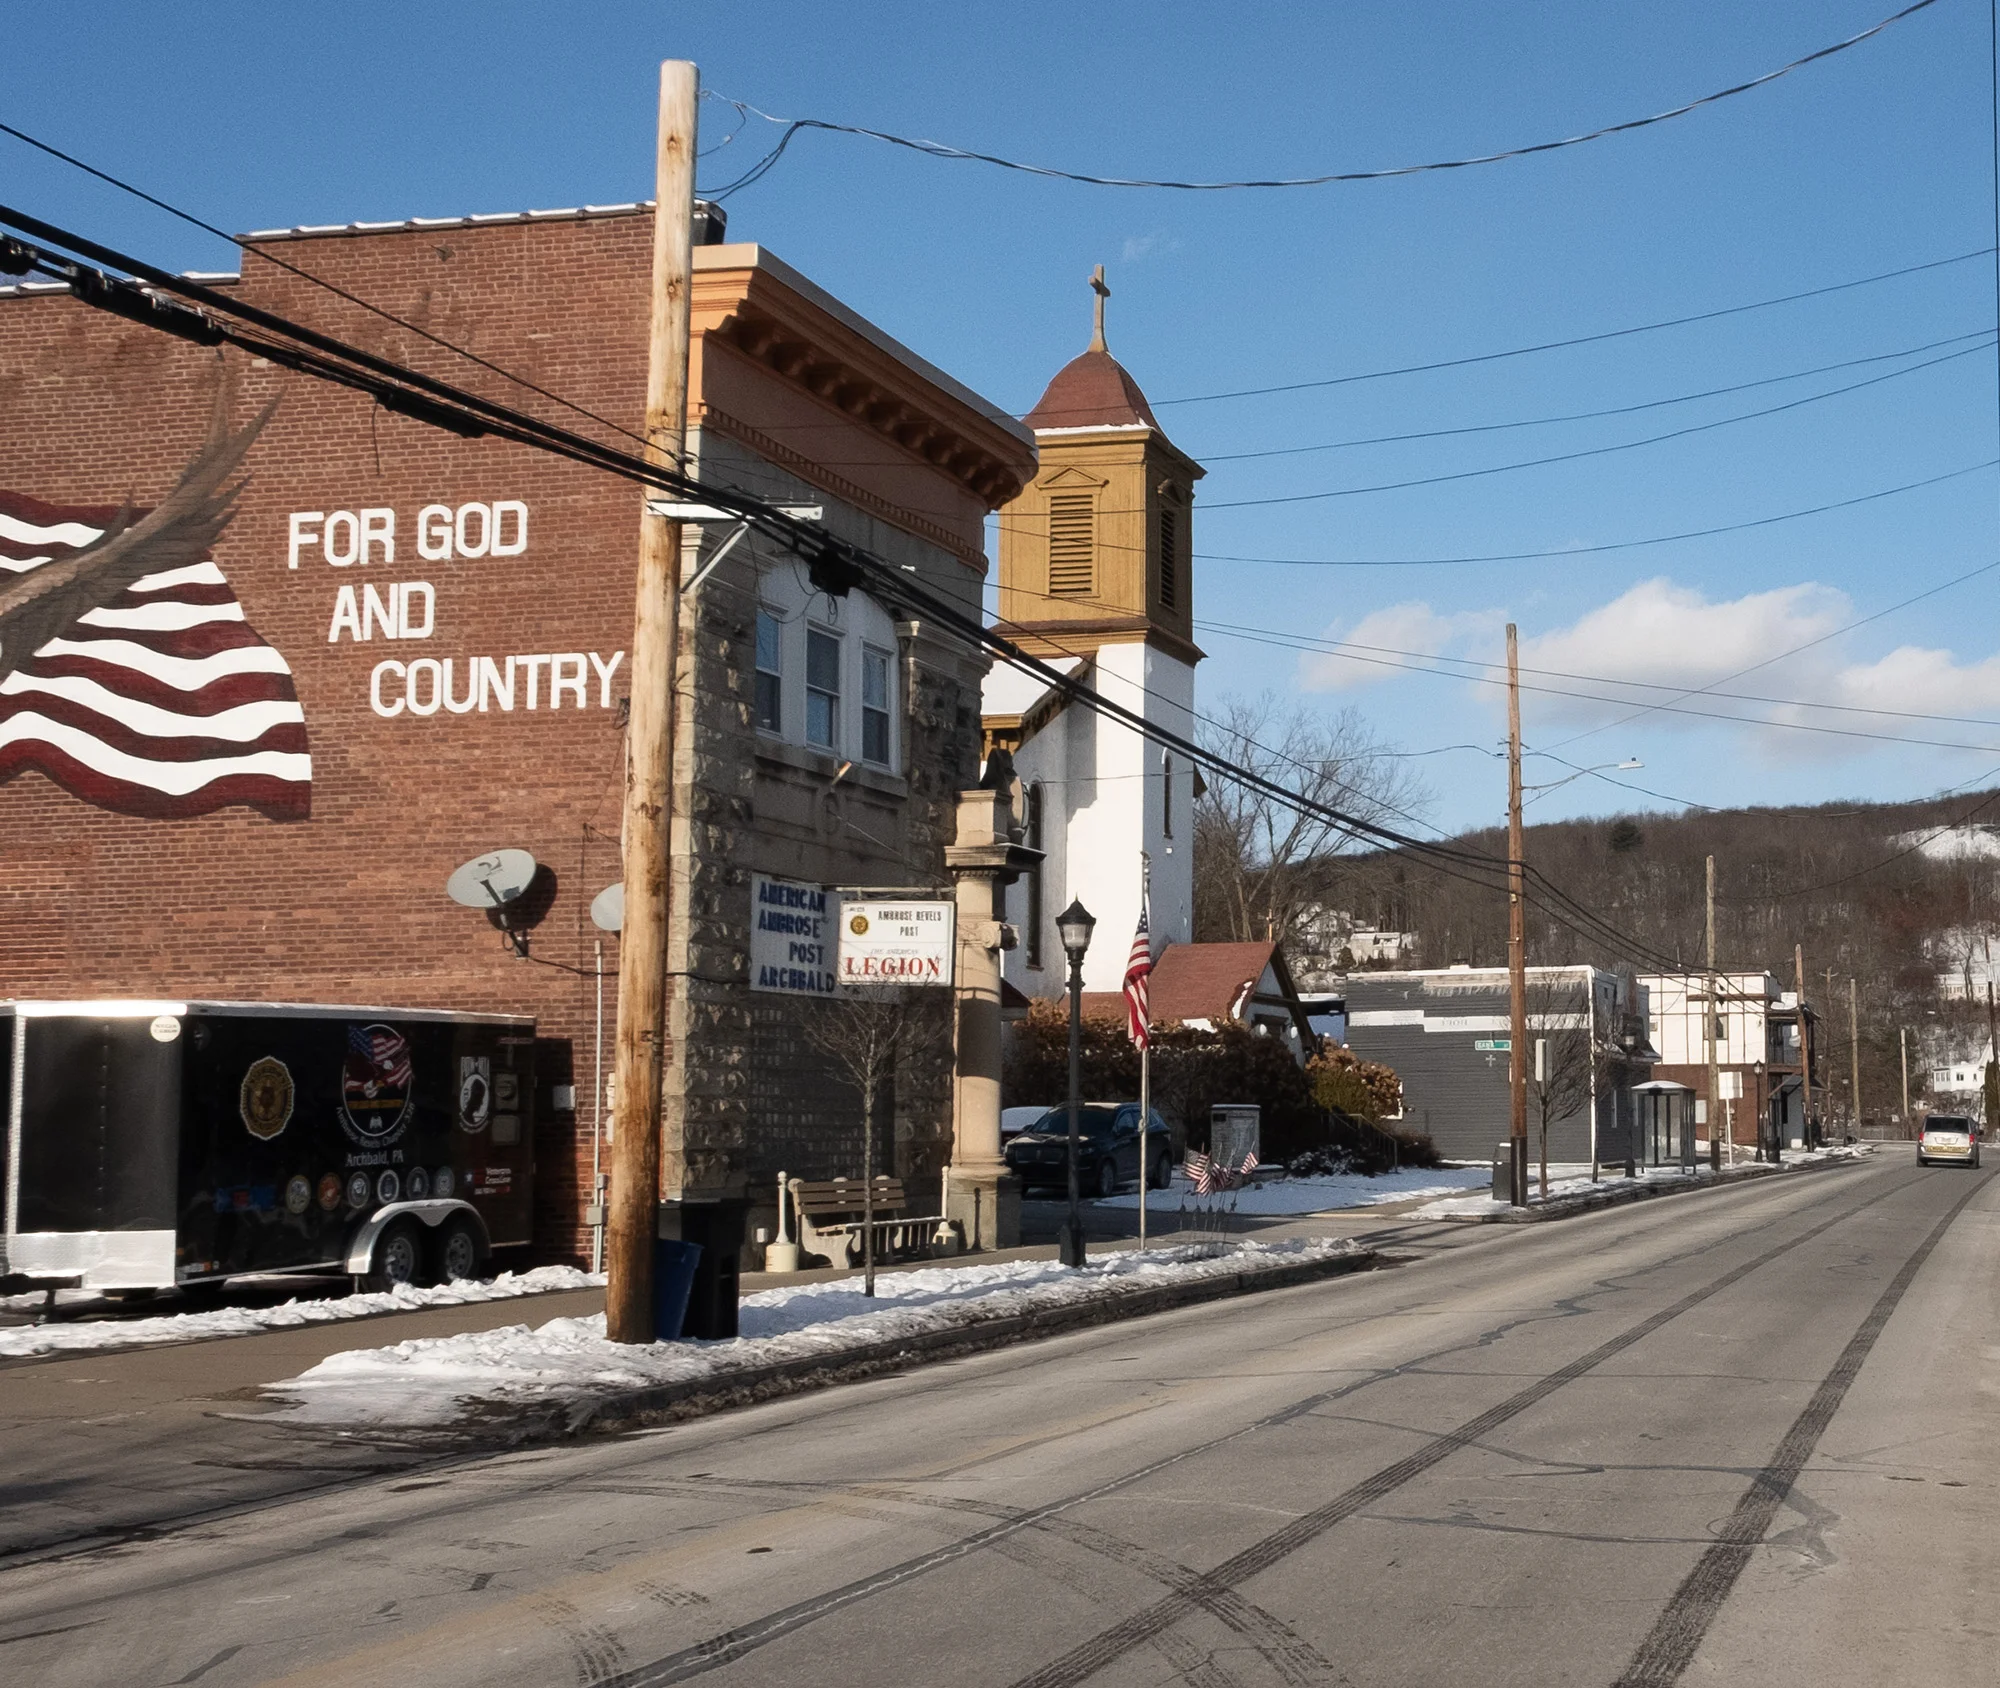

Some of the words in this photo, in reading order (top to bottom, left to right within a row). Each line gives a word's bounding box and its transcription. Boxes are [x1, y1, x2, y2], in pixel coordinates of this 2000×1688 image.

[288, 508, 395, 569] FOR
[417, 501, 528, 560] GOD
[328, 581, 435, 643] AND
[370, 651, 625, 718] COUNTRY
[759, 882, 827, 914] AMERICAN
[758, 910, 821, 938] AMBROSE
[878, 910, 913, 921] AMBROSE
[900, 926, 919, 937] POST
[788, 942, 825, 965] POST
[845, 956, 940, 976] LEGION
[392, 1148, 404, 1163] PA
